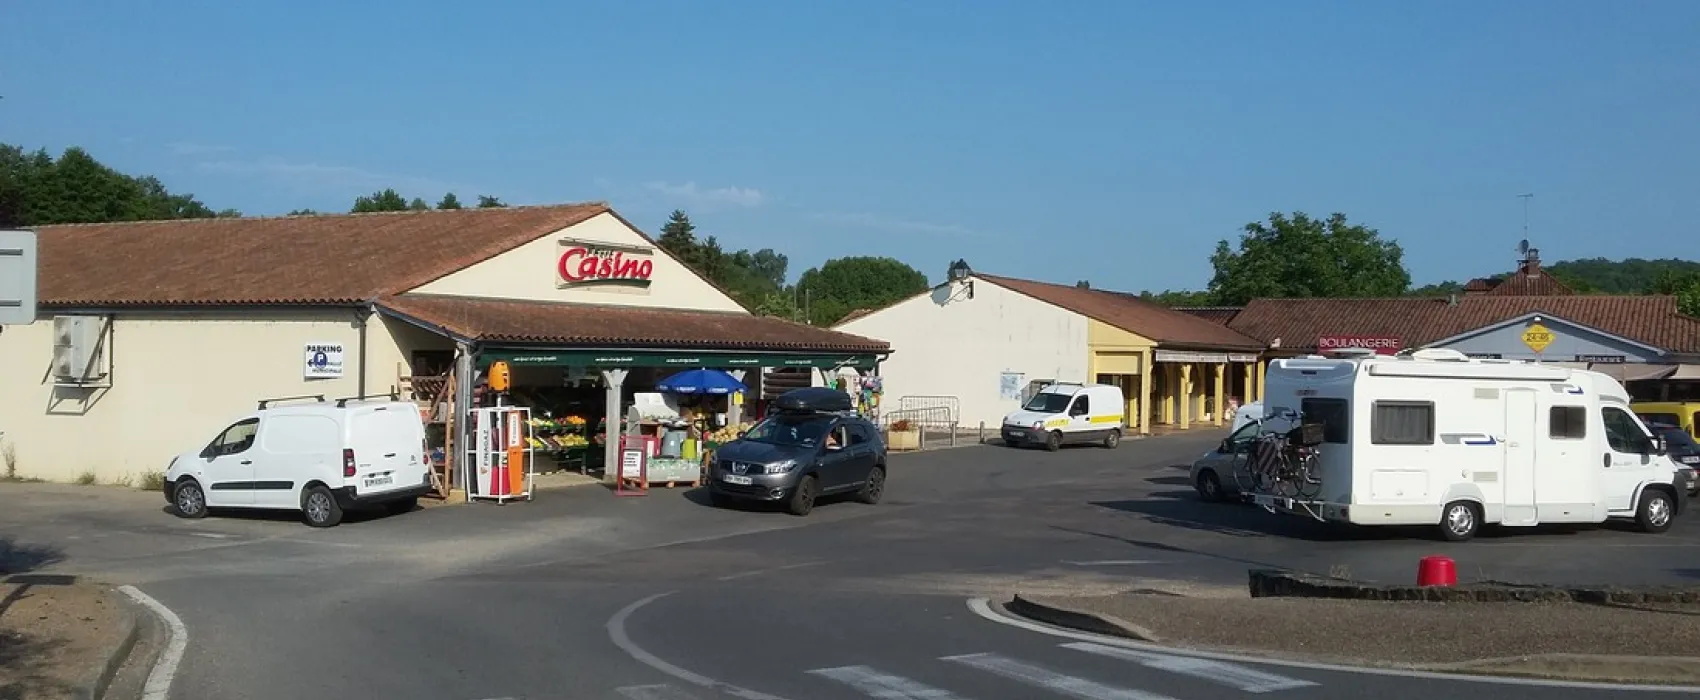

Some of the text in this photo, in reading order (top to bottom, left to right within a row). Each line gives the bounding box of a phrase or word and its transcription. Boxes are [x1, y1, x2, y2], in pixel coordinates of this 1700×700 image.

[558, 245, 653, 282] Casino
[1319, 338, 1398, 348] BOULANGERIE
[307, 345, 342, 353] PARKING
